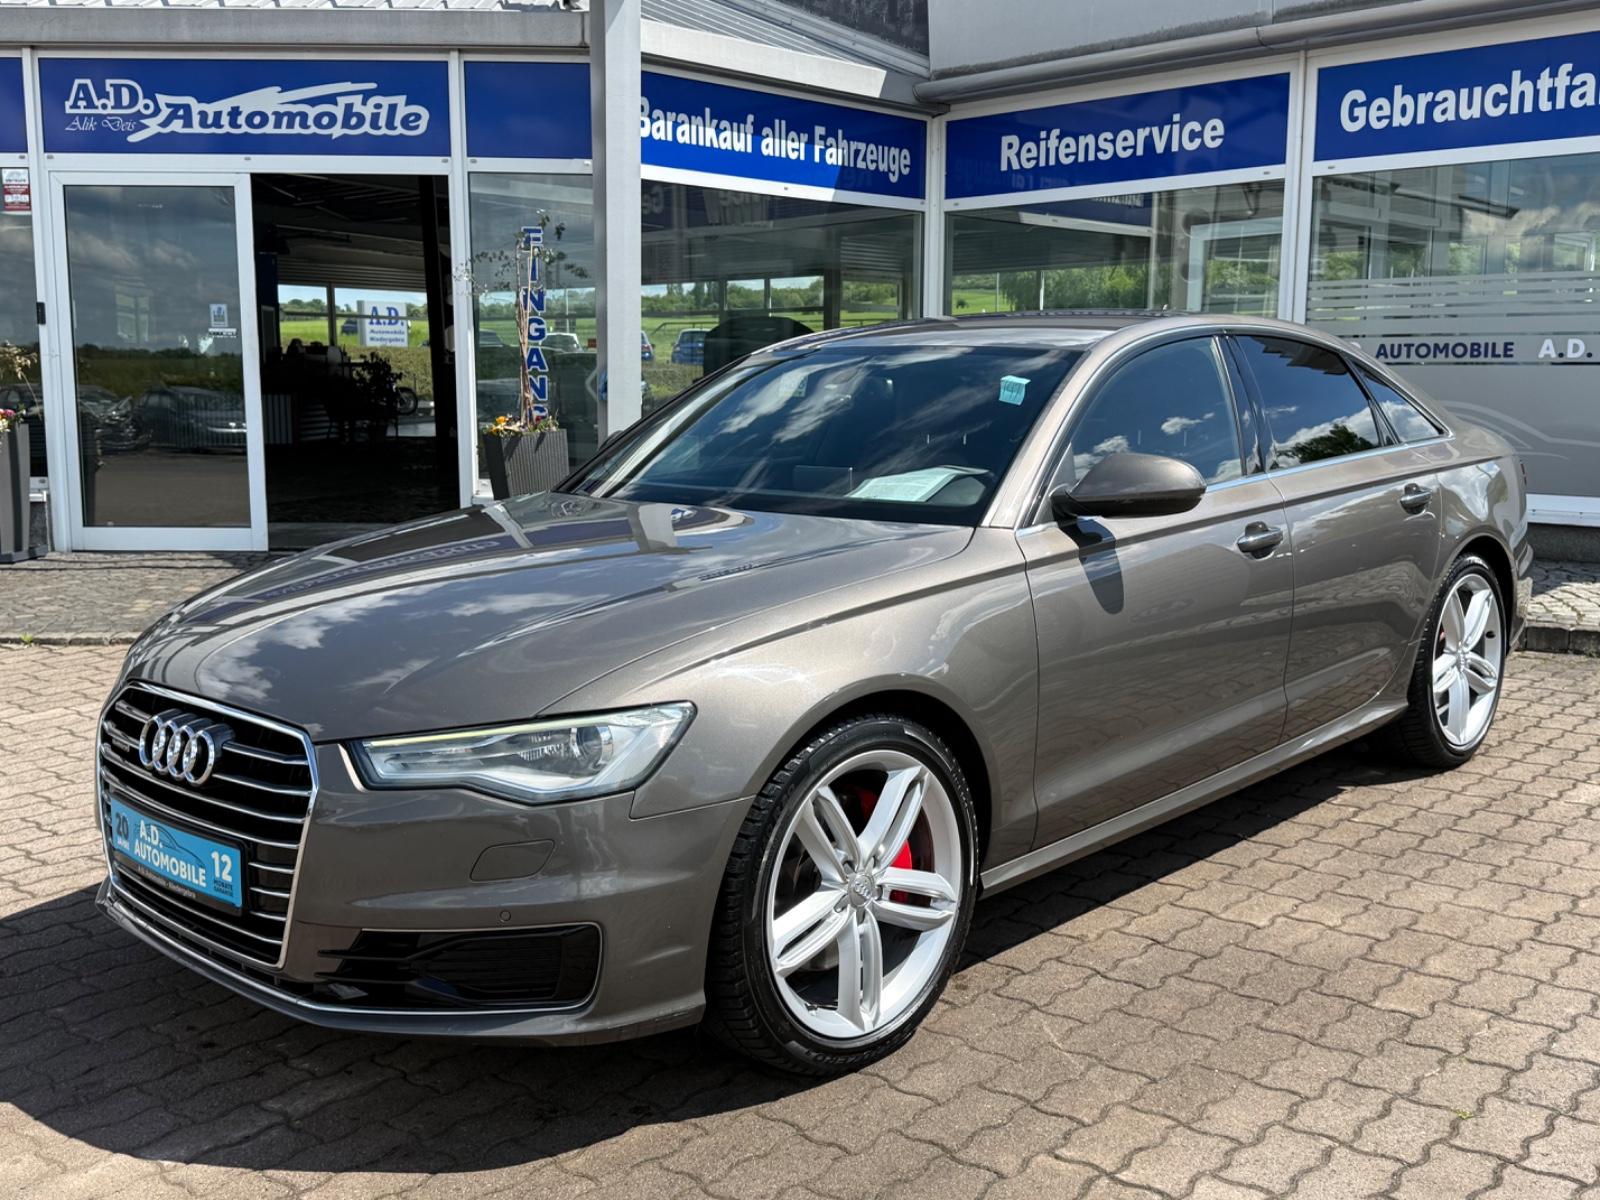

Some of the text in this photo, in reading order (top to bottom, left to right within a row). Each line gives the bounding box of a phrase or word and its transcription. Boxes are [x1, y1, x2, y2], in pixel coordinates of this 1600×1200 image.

[65, 78, 429, 139] A.D. Automobile
[1340, 63, 1600, 132] Gebrauchtfa
[641, 97, 911, 183] Barankauf aller Fahrzeuge
[1000, 113, 1225, 172] Reifenservice
[369, 306, 404, 326] A.D.
[1375, 341, 1515, 359] AUTOMOBILE
[1538, 338, 1593, 359] A.D.
[115, 812, 130, 841] 20
[139, 820, 163, 849] A.D.
[134, 839, 207, 888] AUTOMOBILE
[211, 851, 233, 882] 12
